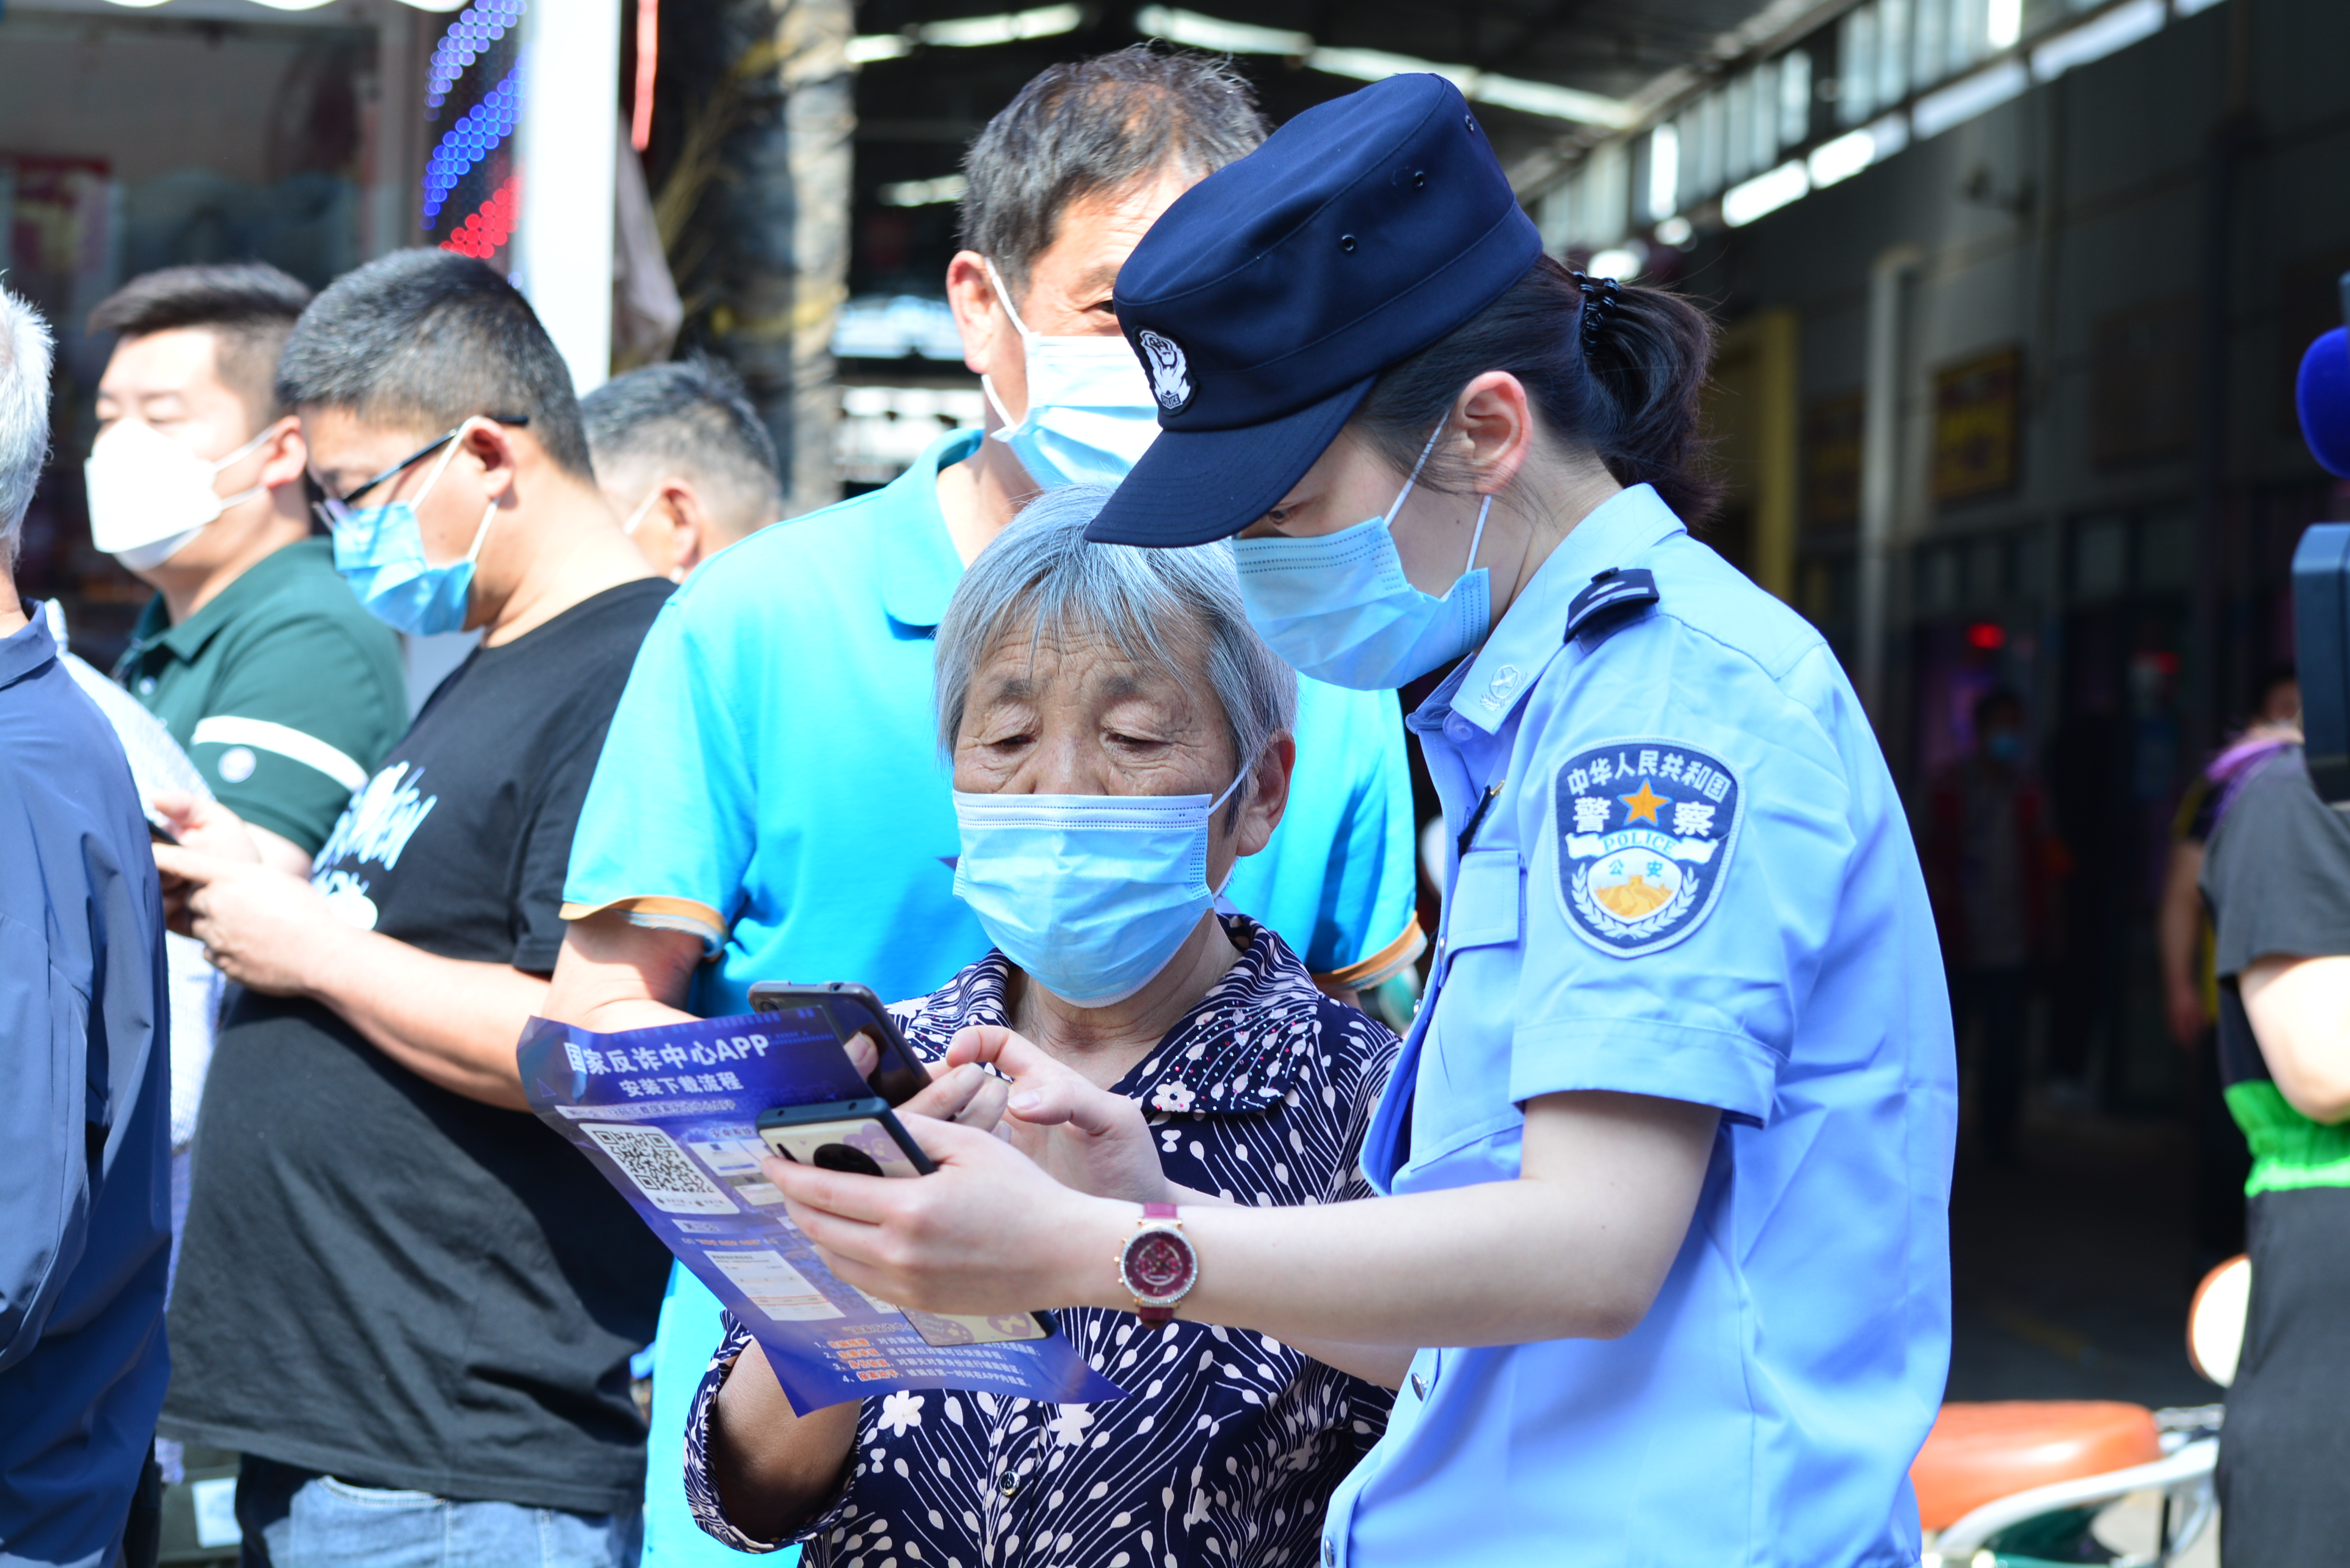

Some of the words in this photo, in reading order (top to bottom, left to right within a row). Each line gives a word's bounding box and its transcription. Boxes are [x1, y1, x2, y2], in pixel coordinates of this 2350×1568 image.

[1161, 395, 1179, 407] POLICE
[1566, 749, 1732, 803] 中华人民共和国
[1603, 830, 1678, 856] POLICE
[563, 1034, 769, 1075] 国家反诈中心APP
[618, 1071, 744, 1098] 安装下载流程
